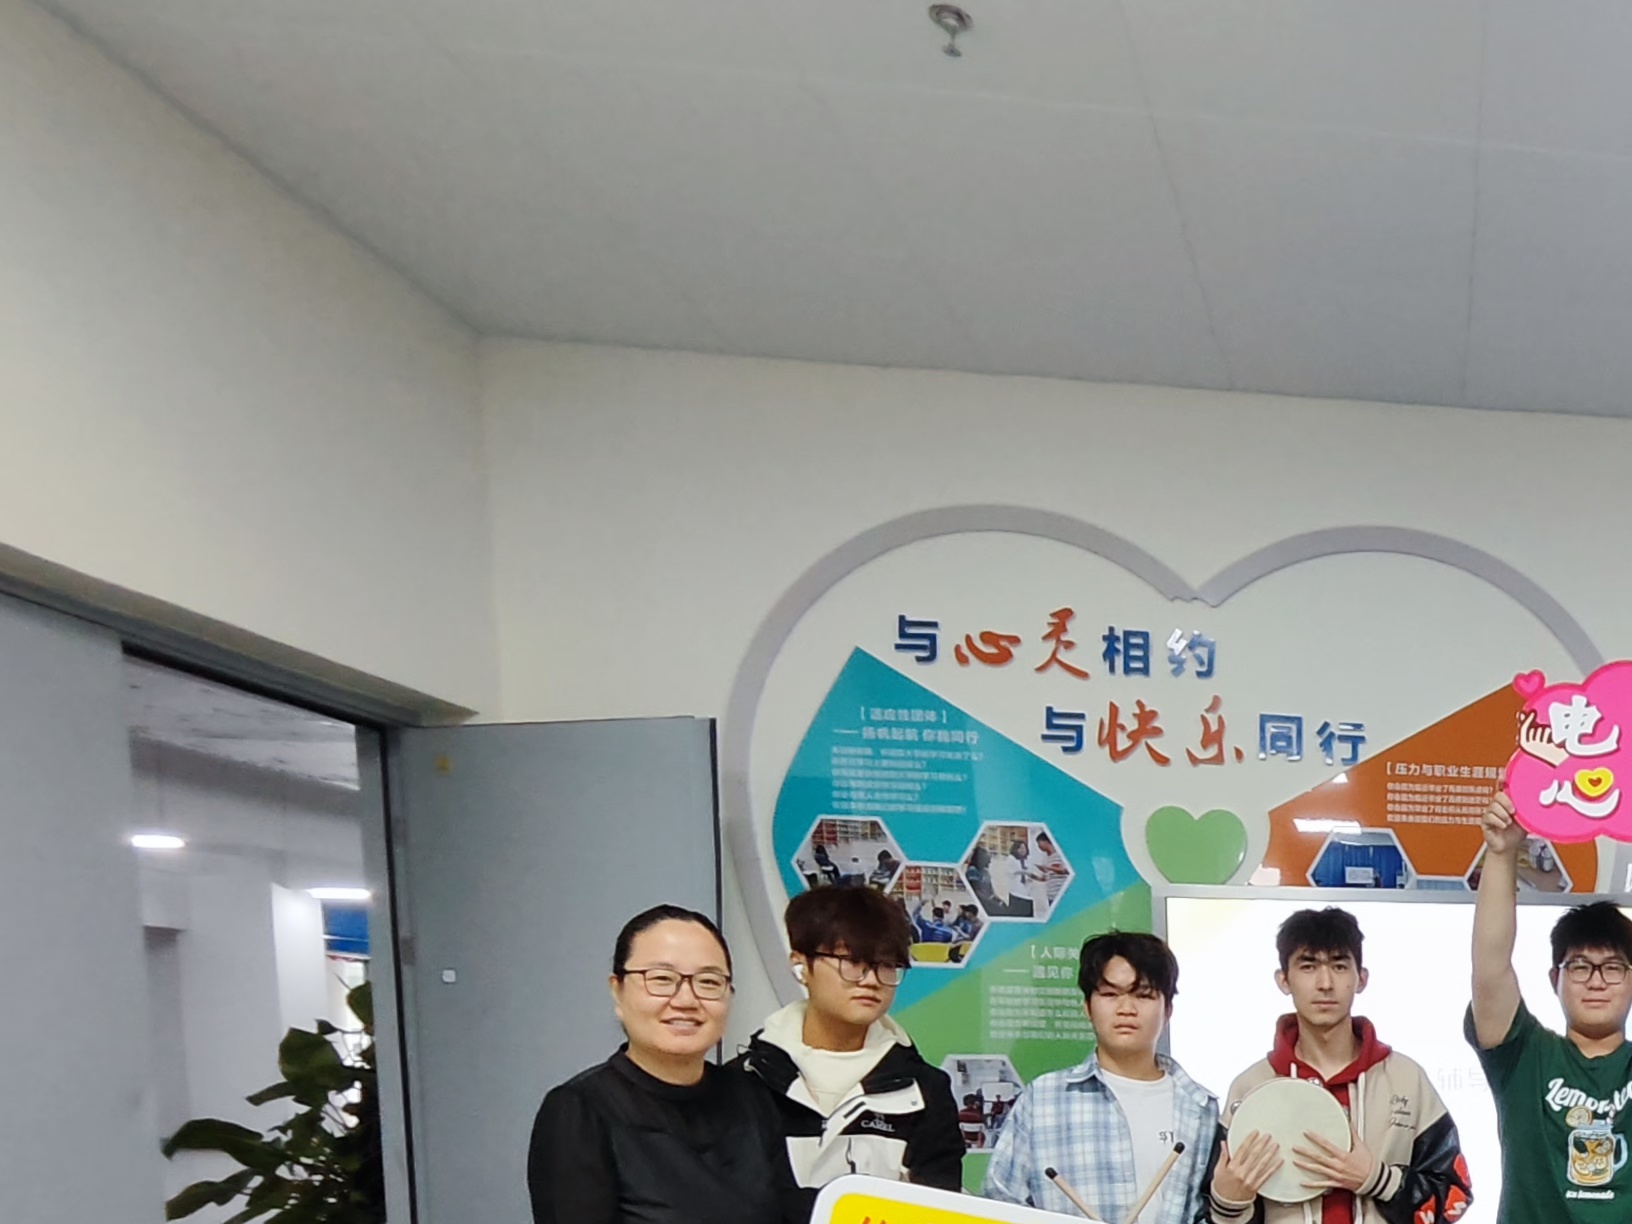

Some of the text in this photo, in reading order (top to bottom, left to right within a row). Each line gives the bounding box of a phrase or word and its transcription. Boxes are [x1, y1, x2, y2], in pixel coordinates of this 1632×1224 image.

[894, 607, 1216, 679] 与心灵相约
[1041, 695, 1367, 767] 与快乐同行
